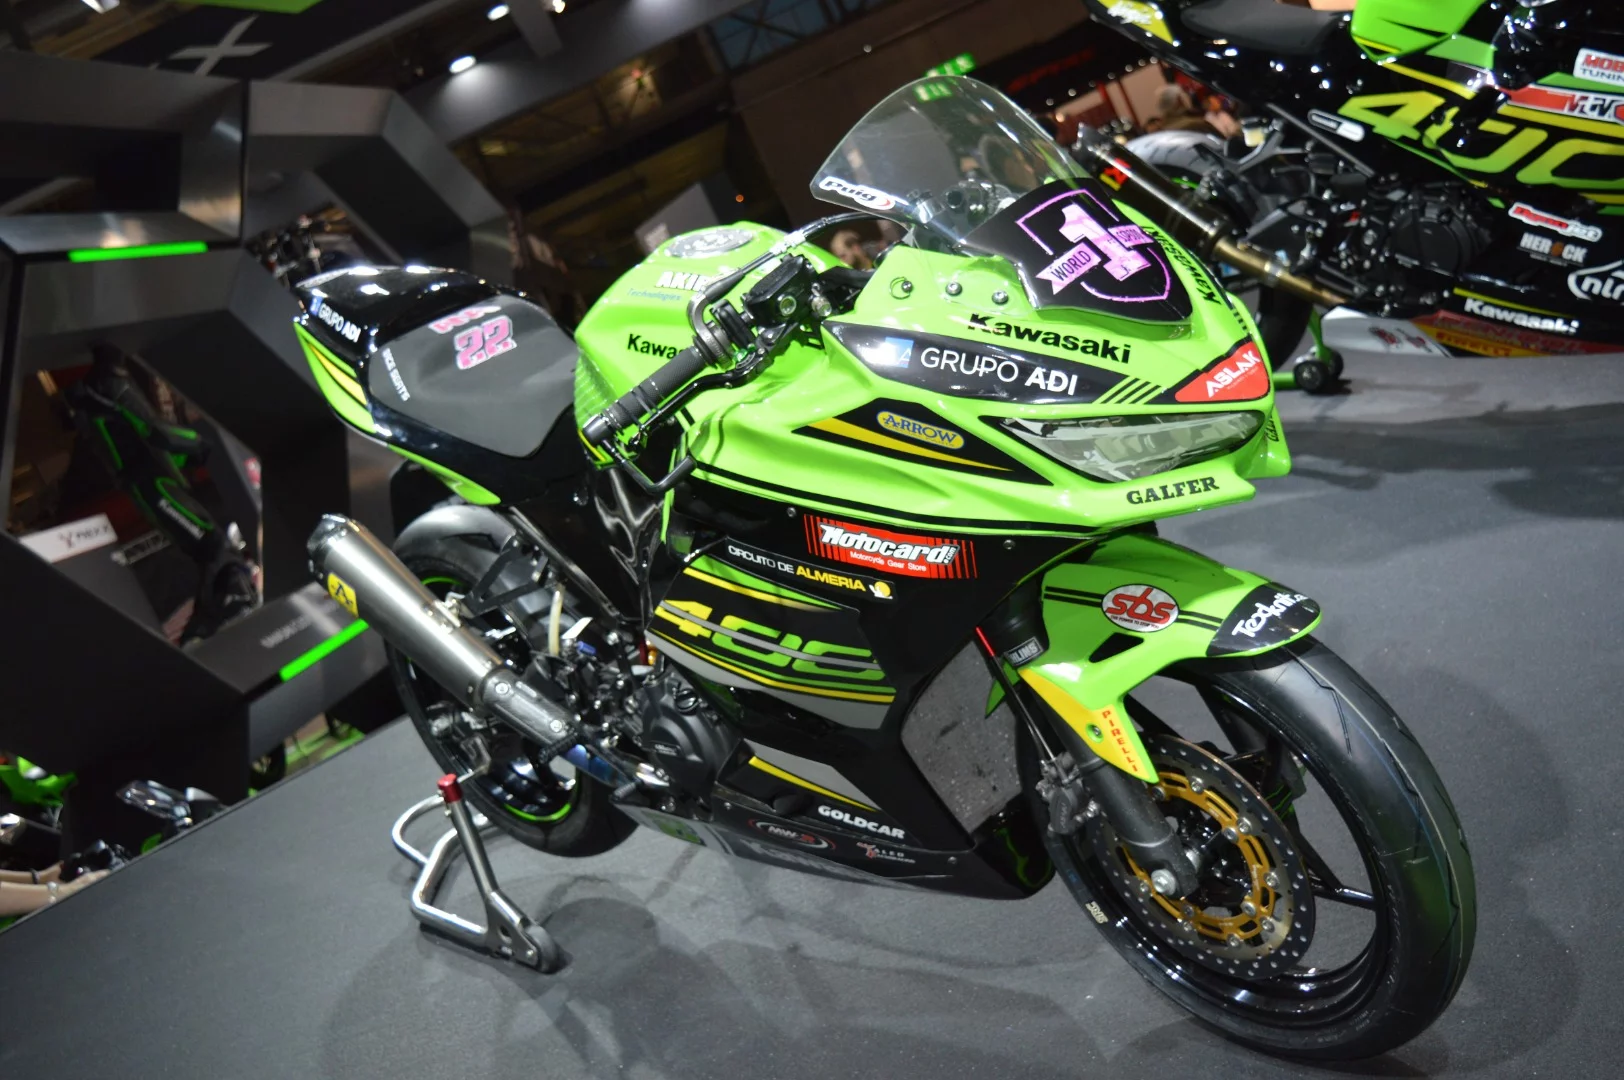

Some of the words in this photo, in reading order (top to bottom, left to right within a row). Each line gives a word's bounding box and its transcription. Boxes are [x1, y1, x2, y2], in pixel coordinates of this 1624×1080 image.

[823, 180, 878, 202] Puig
[1058, 202, 1151, 282] 1
[1050, 249, 1092, 283] WORLD
[318, 303, 344, 332] GRUPO
[341, 319, 362, 343] ADI
[1464, 297, 1580, 334] Kawasaki
[454, 315, 518, 370] 22
[966, 312, 1131, 364] Kawasaki
[920, 346, 1019, 383] GRUPO
[1024, 366, 1079, 397] ADI
[1205, 350, 1262, 399] ASLAK
[884, 414, 958, 444] ARROW
[1126, 476, 1220, 505] GALFER
[727, 544, 777, 569] CIRCUITO
[777, 560, 795, 575] DE
[795, 565, 867, 593] ALMERIA
[849, 550, 885, 566] Motorcycle
[886, 558, 905, 570] Gear
[907, 562, 928, 573] Store
[1104, 586, 1177, 625] sbs
[1101, 709, 1138, 773] PIRELLI
[817, 804, 906, 840] GOLDCAR
